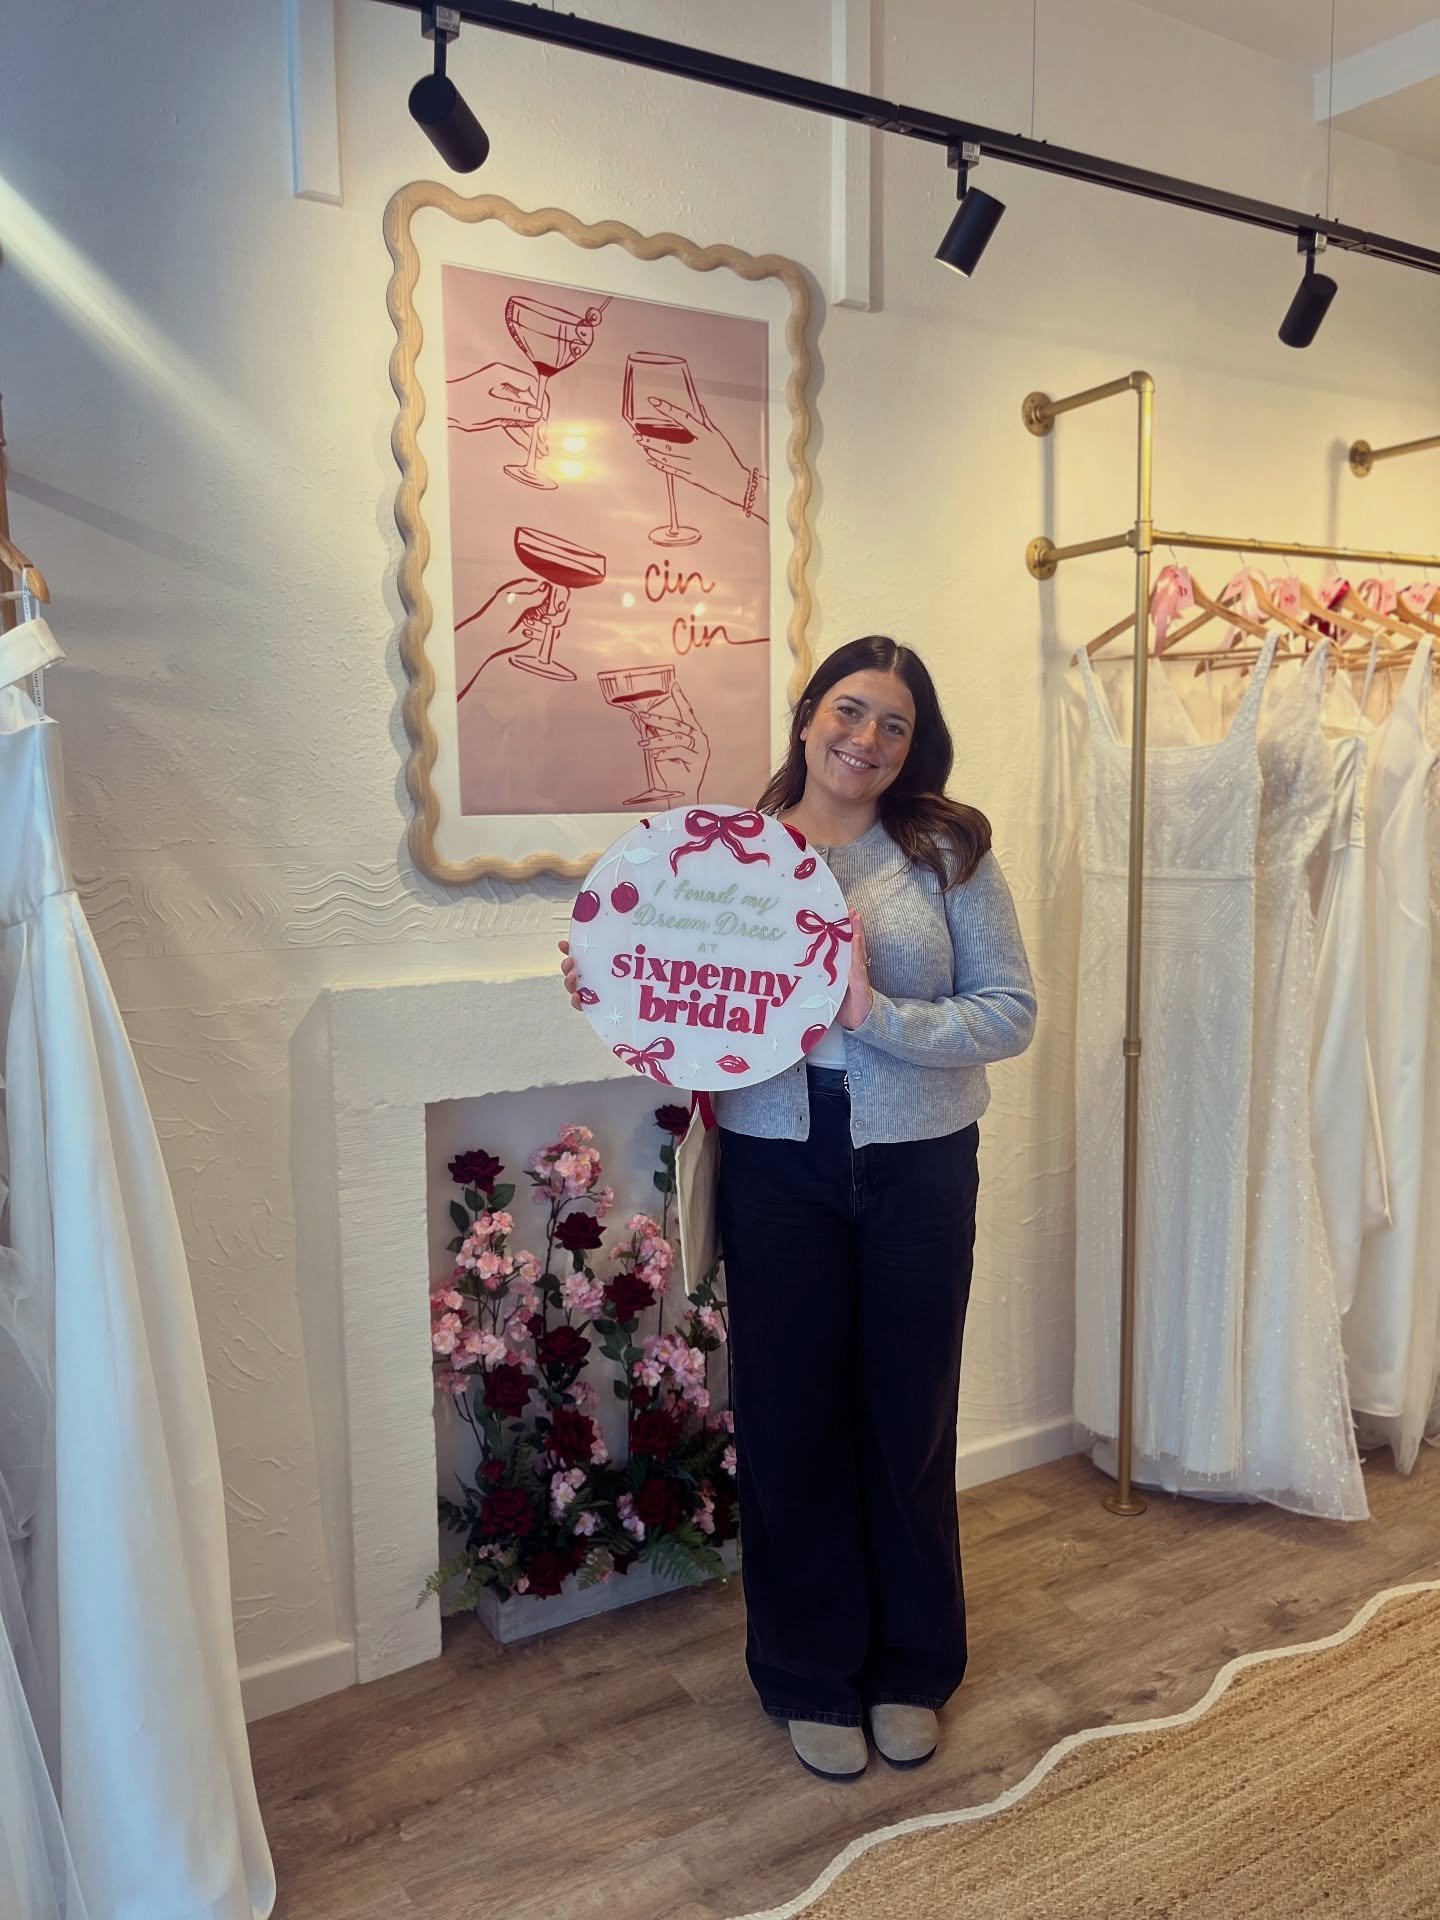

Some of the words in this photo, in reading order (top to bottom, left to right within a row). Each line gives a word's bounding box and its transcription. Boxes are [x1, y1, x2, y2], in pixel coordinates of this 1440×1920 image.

[645, 559, 716, 603] cin
[672, 614, 770, 656] cin
[654, 879, 666, 897] I
[673, 879, 738, 905] found
[740, 894, 780, 917] my
[632, 903, 711, 929] Dream
[713, 911, 787, 941] Dress
[698, 943, 718, 953] AT
[611, 944, 802, 1008] sixpenny
[638, 984, 769, 1035] bridal
